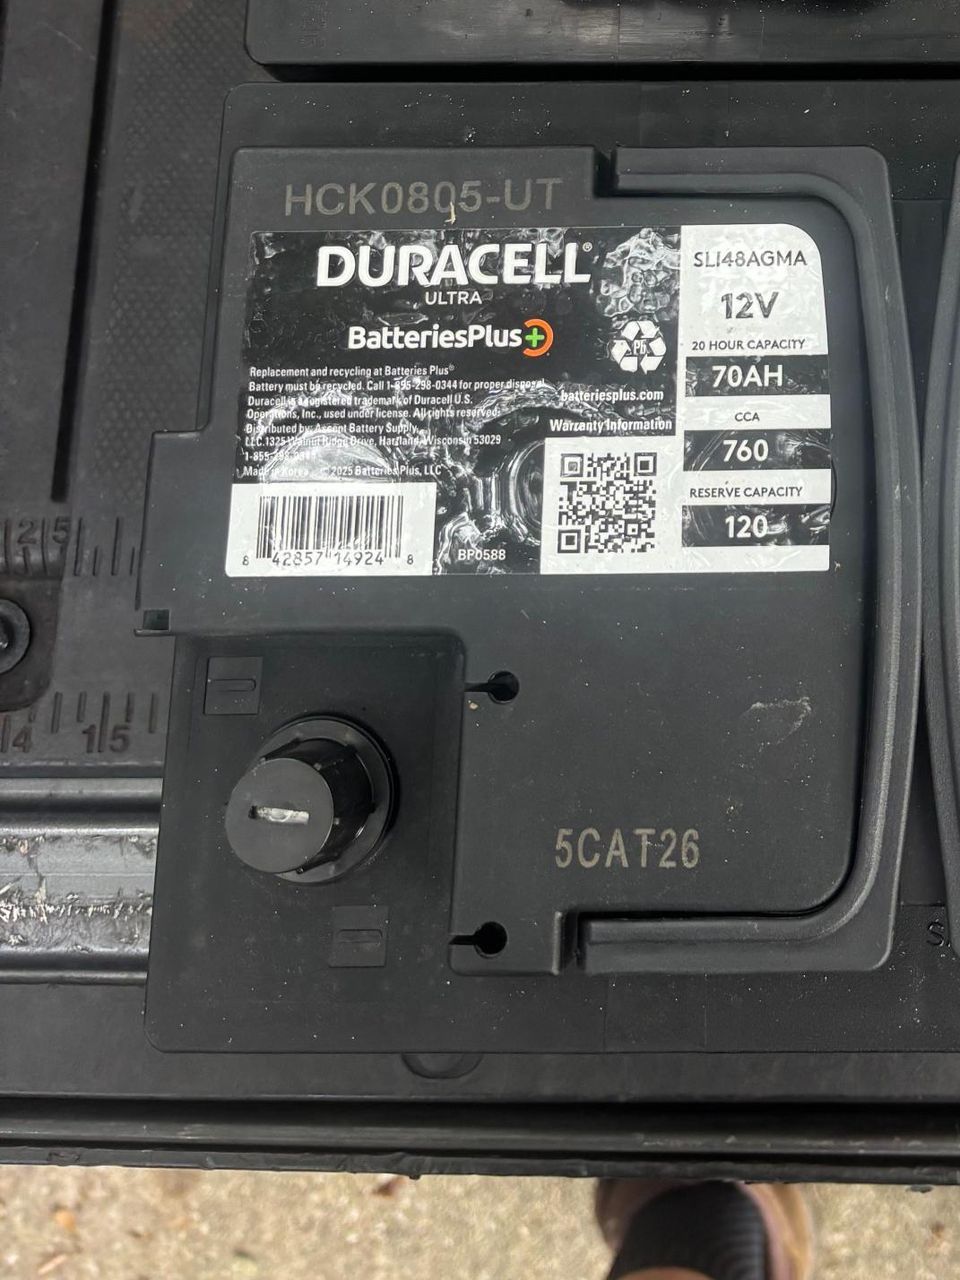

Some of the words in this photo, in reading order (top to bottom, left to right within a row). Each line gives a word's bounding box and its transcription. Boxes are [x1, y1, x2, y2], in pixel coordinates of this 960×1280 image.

[285, 178, 561, 216] HCK0805-UT
[694, 251, 807, 268] SLI48AGMA
[425, 290, 482, 305] ULTRA
[721, 292, 779, 319] 12V
[692, 340, 706, 350] 20
[709, 339, 744, 350] HOUR
[747, 338, 805, 350] CAPACITY
[250, 367, 308, 377] Replacement
[311, 368, 327, 376] and
[329, 367, 371, 377] recycling
[374, 368, 382, 376] at
[385, 367, 427, 376] Batteries
[712, 365, 783, 388] 70AH
[561, 388, 664, 402] batteriesplus.com
[735, 412, 760, 422] CCA
[550, 419, 603, 432] Warranty
[606, 419, 672, 431] Information
[723, 440, 769, 462] 760
[690, 486, 741, 498] RESERVE
[744, 485, 803, 497] CAPACITY
[725, 516, 769, 538] 120
[243, 557, 249, 566] 8
[407, 556, 414, 564] 8
[458, 548, 506, 561] BP0588
[555, 828, 700, 869] 5CAT26
